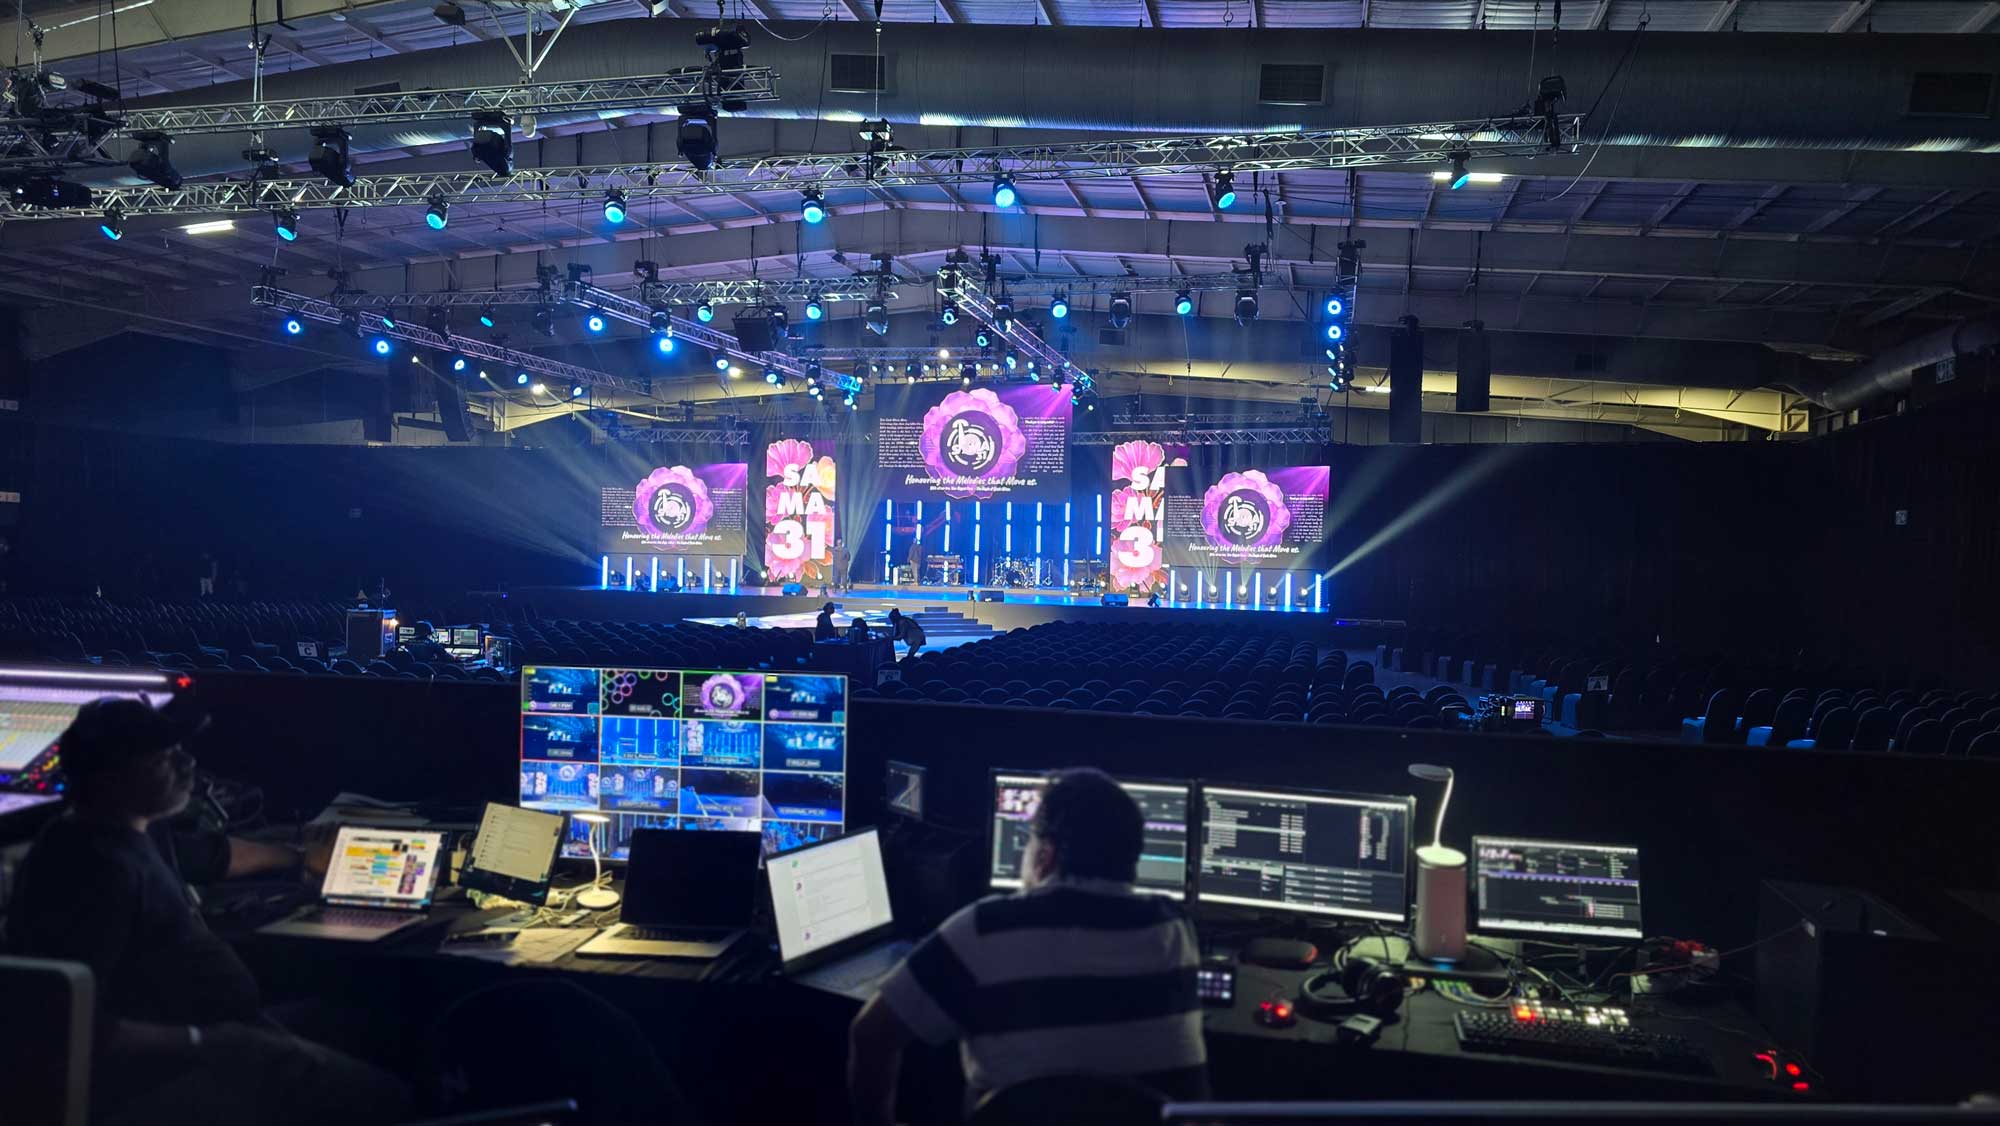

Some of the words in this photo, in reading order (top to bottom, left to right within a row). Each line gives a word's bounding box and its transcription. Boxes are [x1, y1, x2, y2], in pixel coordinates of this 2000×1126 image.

[783, 463, 820, 487] SA
[905, 474, 940, 487] Honouring
[943, 475, 954, 485] the
[956, 475, 986, 486] Melodies
[987, 475, 1004, 486] that
[1005, 476, 1025, 486] Move
[777, 492, 826, 515] MA
[772, 519, 826, 560] 31
